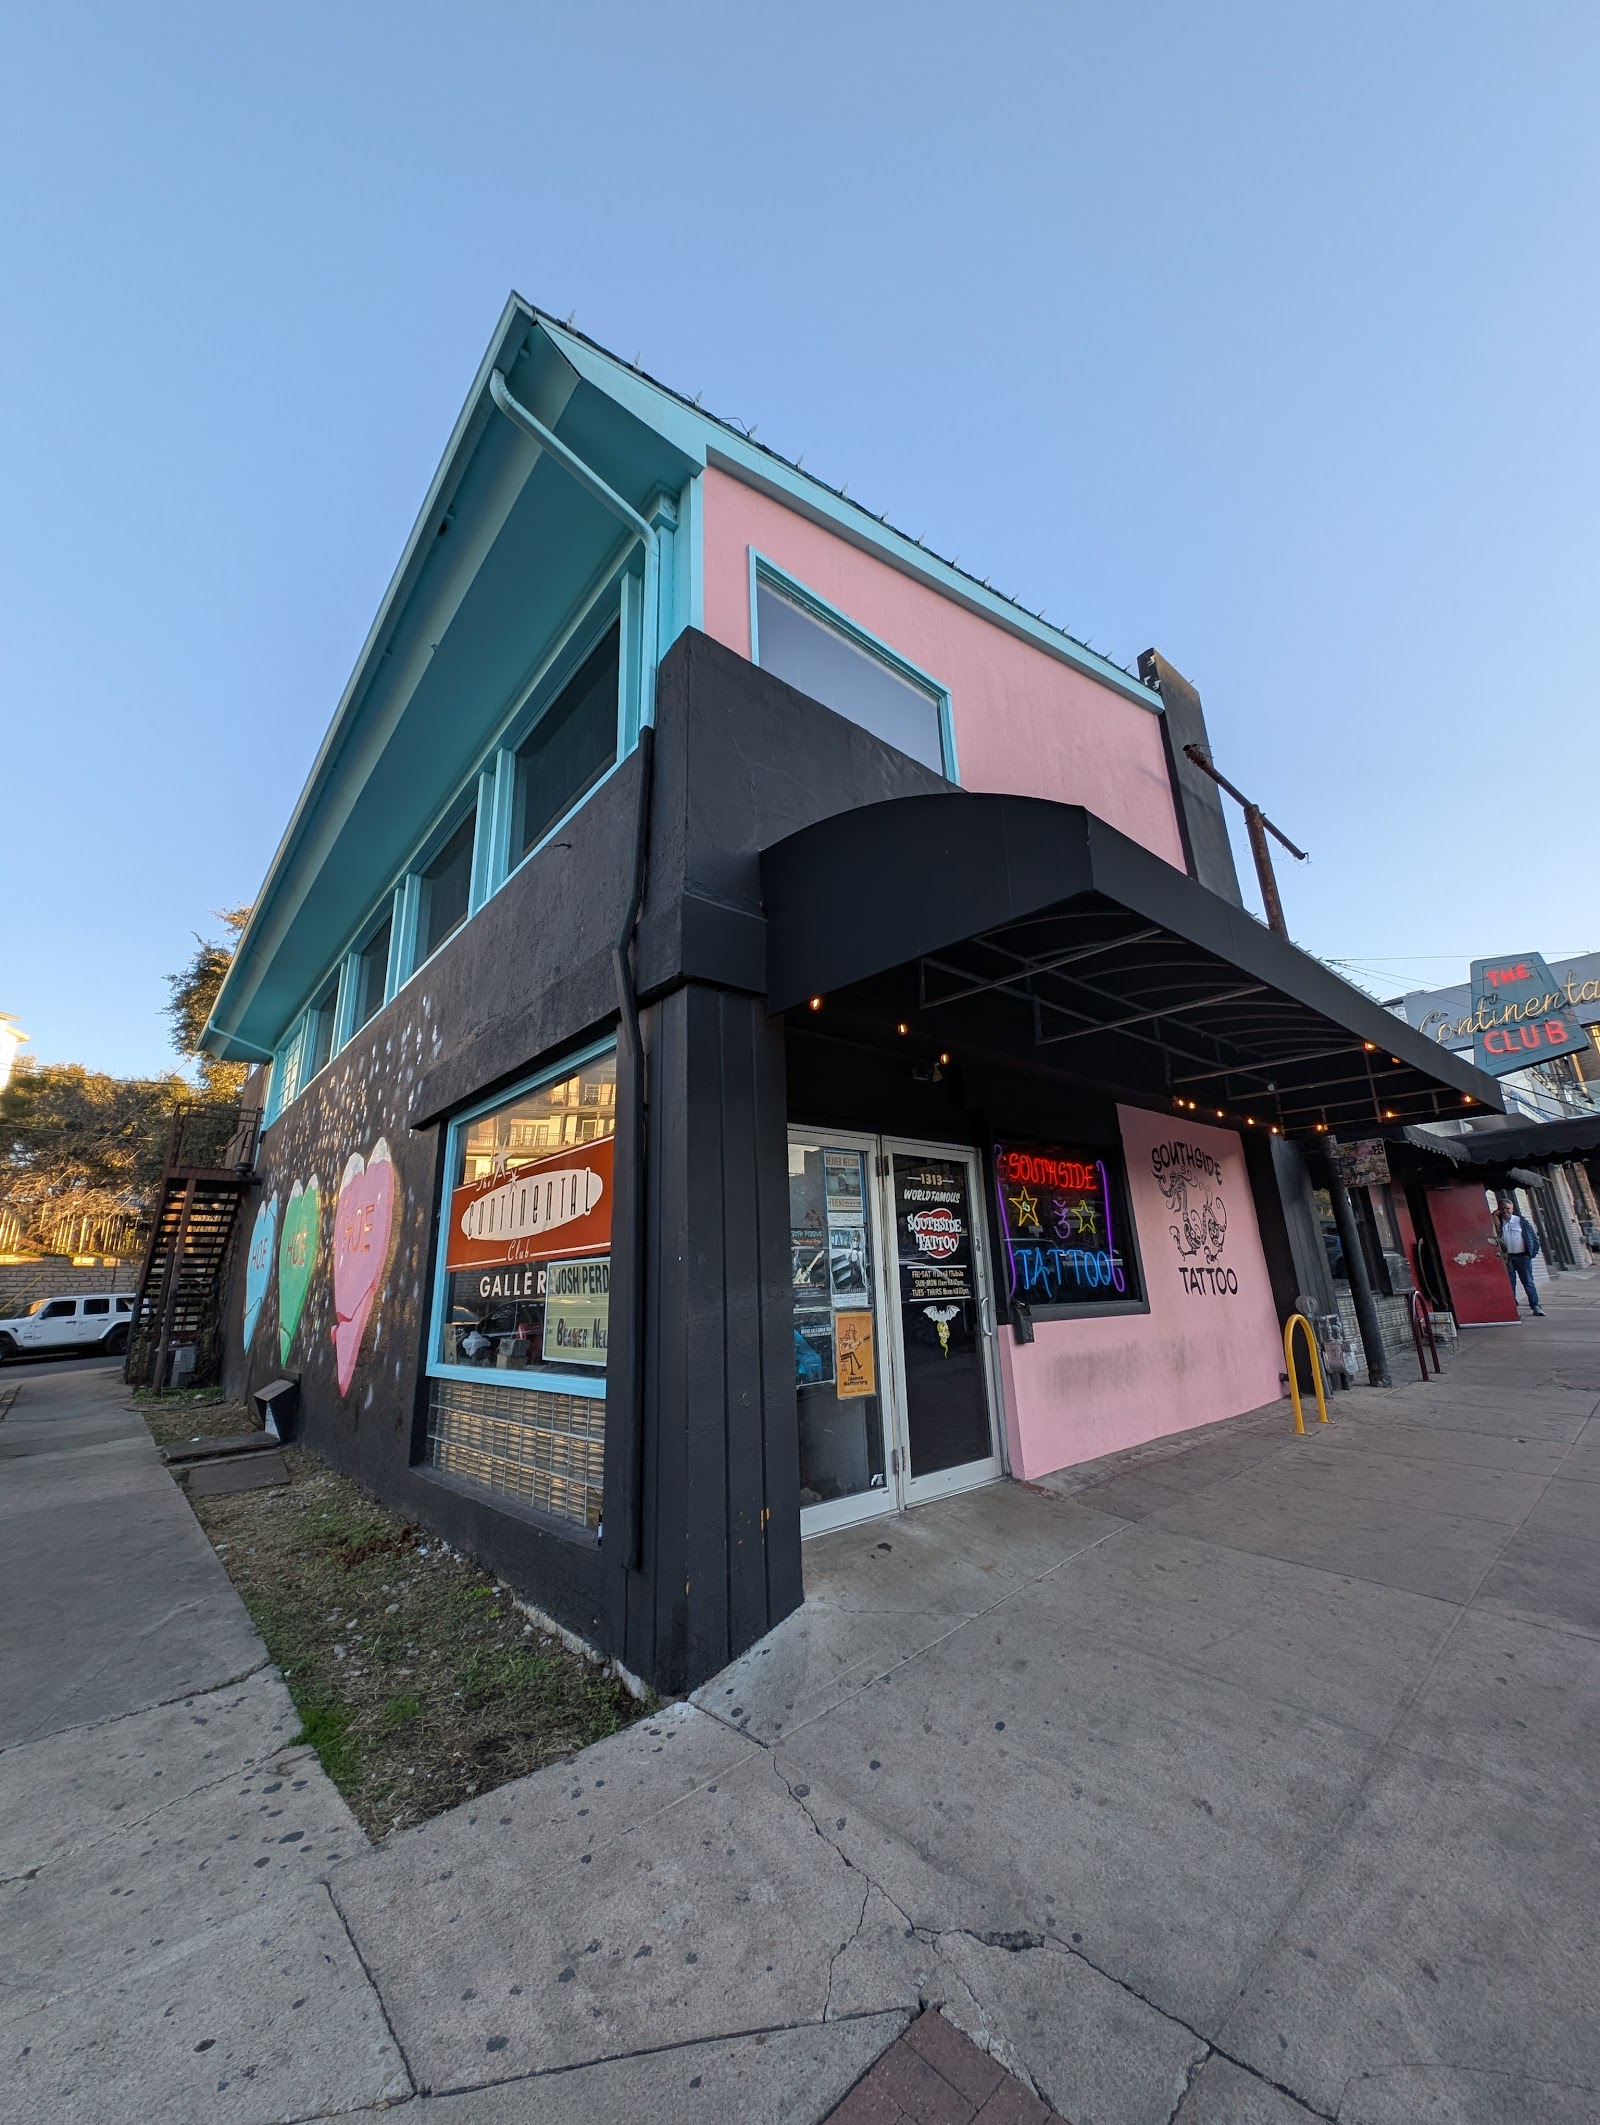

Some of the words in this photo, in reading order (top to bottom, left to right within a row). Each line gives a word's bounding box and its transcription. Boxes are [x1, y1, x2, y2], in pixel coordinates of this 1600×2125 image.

[1485, 963, 1534, 988] THE
[1484, 1020, 1569, 1054] CLUB
[1008, 1153, 1098, 1190] SOUTHSIDE
[1151, 1141, 1222, 1186] SOUTHSIDE
[475, 1173, 491, 1191] The
[920, 1174, 943, 1186] 1313
[904, 1188, 931, 1202] WORLD
[931, 1191, 961, 1203] FAMOUS
[907, 1213, 962, 1233] SOUTHSIDE
[507, 1239, 531, 1262] Club
[916, 1233, 957, 1252] TATTOO
[556, 1267, 580, 1295] JOSH
[1014, 1247, 1112, 1298] TATTOO
[1178, 1266, 1239, 1296] TATTOO
